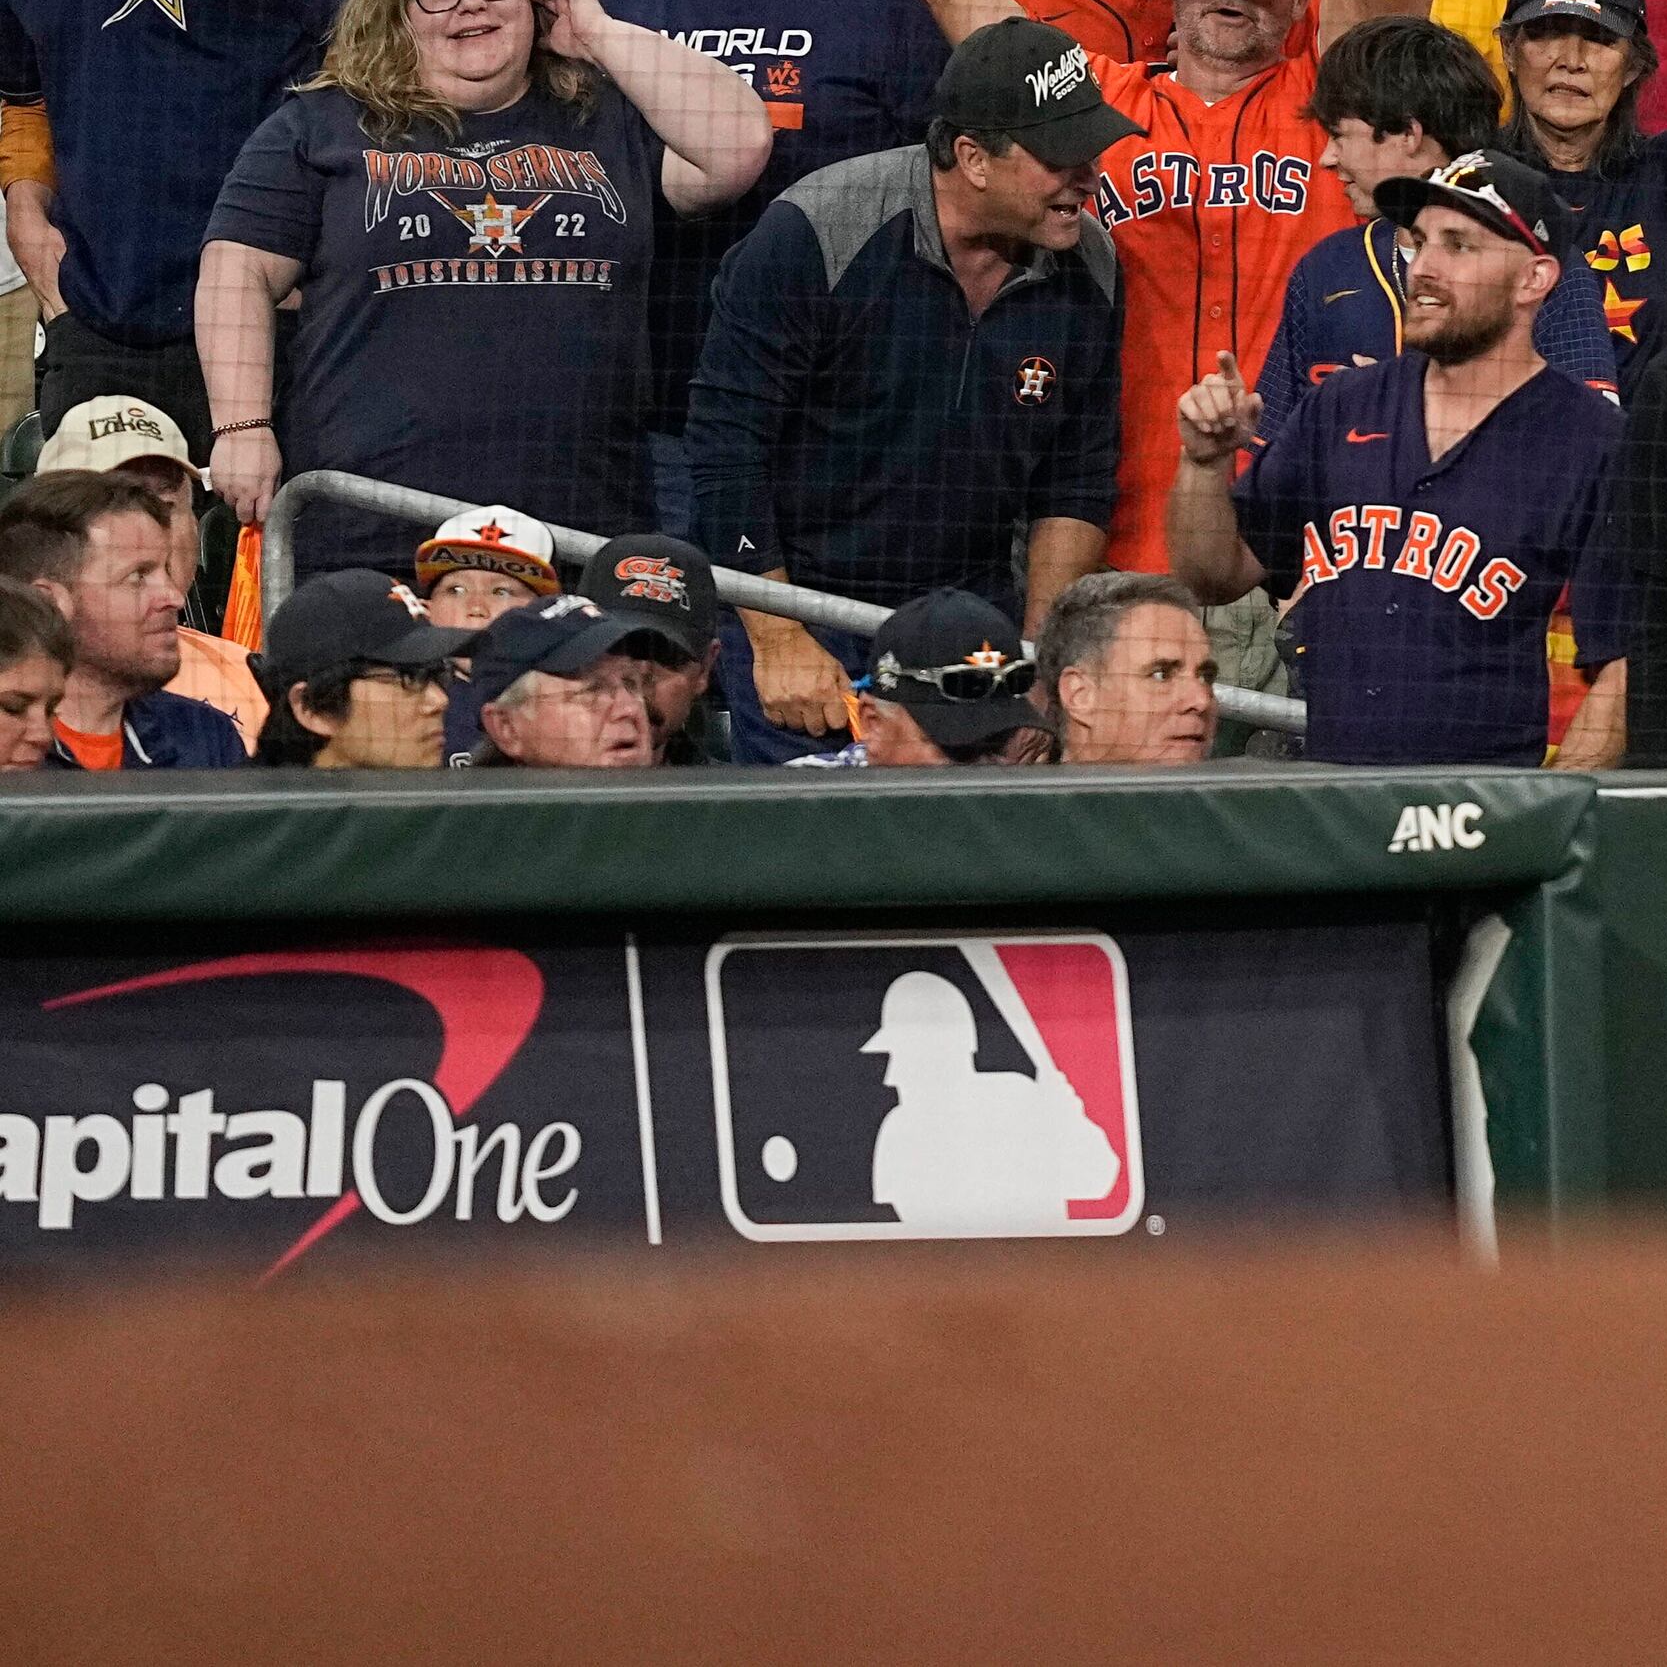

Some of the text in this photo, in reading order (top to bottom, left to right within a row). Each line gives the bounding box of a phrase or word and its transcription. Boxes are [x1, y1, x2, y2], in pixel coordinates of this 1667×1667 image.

[660, 28, 813, 57] WORLD
[363, 143, 628, 233] WORLD SERIES
[1092, 149, 1311, 232] ASTROS
[398, 213, 586, 241] 20 22
[377, 261, 612, 290] HOUSTON ASTROS
[87, 411, 164, 441] Lakes
[429, 547, 544, 578] Astros
[1303, 504, 1528, 621] ASTROS
[1388, 801, 1486, 852] ANC
[352, 1078, 583, 1226] One
